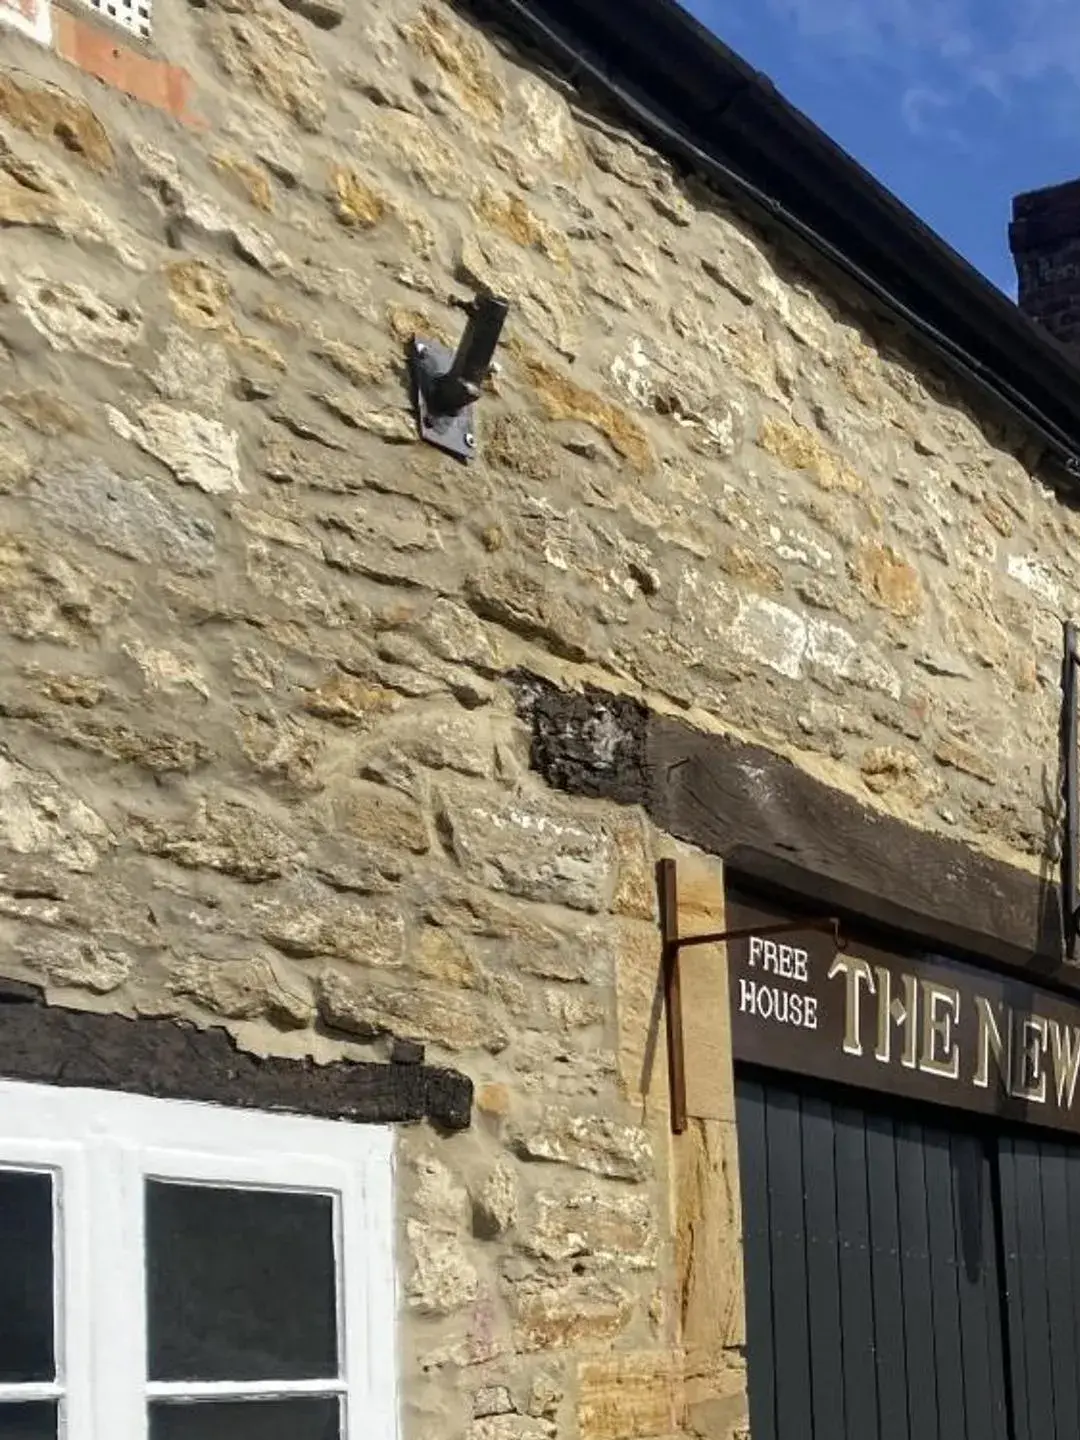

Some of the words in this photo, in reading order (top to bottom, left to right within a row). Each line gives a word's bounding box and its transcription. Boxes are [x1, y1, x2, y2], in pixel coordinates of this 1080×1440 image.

[747, 935, 809, 984] FREE
[738, 977, 819, 1031] HOUSE
[827, 951, 961, 1081] THE
